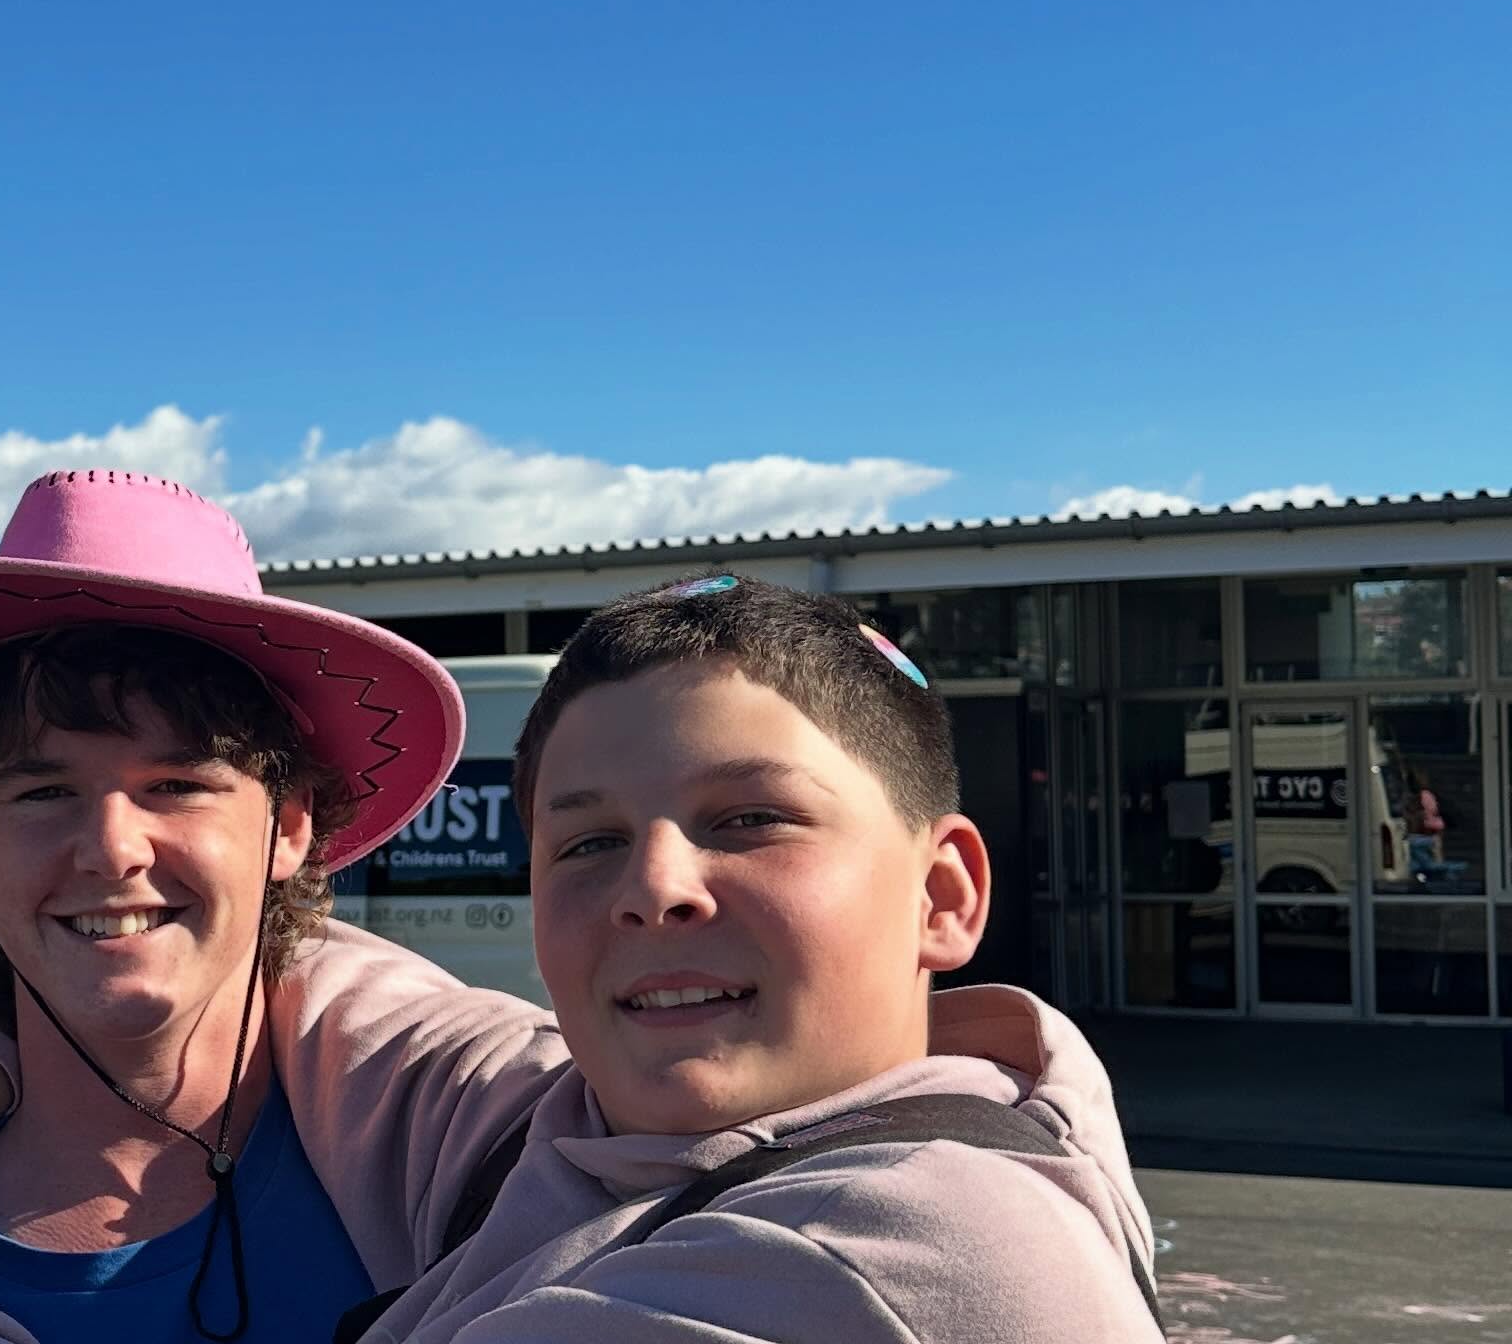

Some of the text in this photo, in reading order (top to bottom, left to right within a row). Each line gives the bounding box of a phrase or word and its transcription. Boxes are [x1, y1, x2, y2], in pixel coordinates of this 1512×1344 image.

[399, 785, 511, 842] UST
[390, 849, 465, 867] Childrens
[467, 849, 509, 867] Trust
